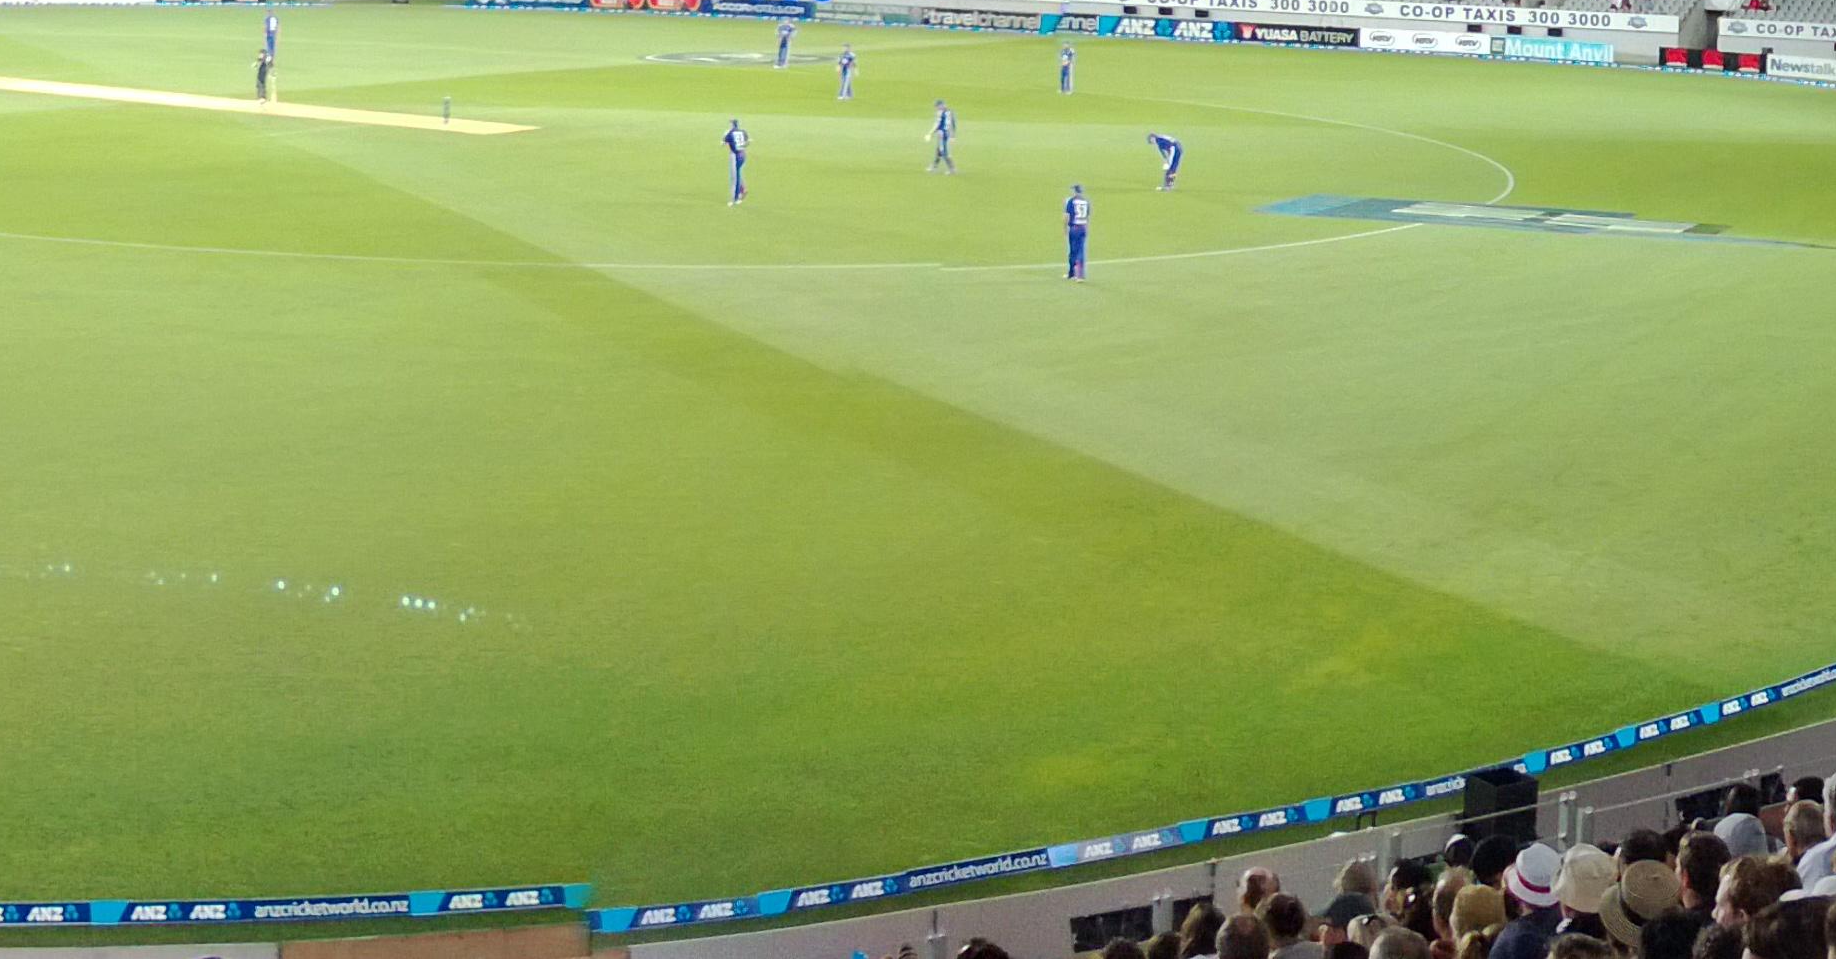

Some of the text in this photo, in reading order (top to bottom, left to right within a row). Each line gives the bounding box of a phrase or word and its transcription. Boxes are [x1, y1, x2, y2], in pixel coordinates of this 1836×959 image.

[1307, 0, 1350, 14] 3000
[1400, 4, 1612, 27] CO-OP TAXIS 300 3000
[1116, 17, 1156, 36] ANZ
[1173, 20, 1213, 38] ANZ
[1756, 22, 1805, 36] CO-OP
[1256, 27, 1298, 41] YUASA
[1300, 29, 1354, 44] BATTERY
[1505, 37, 1566, 59] Mount
[1770, 57, 1836, 77] Newstalk
[1335, 796, 1364, 813] ANZ
[1378, 788, 1405, 805] ANZ
[1212, 818, 1241, 836] ANZ
[1258, 810, 1288, 827] ANZ
[1084, 842, 1114, 858] ANZ
[1133, 834, 1163, 849] ANZ
[909, 852, 1048, 889] anzcricketworld.co.nz
[505, 890, 540, 906] ANZ
[796, 889, 831, 906] ANZ
[851, 881, 885, 899] ANZ
[448, 893, 484, 909] ANZ
[699, 901, 734, 918] ANZ
[27, 906, 65, 921] ANZ
[131, 905, 167, 920] ANZ
[189, 904, 226, 920] ANZ
[641, 908, 677, 925] ANZ
